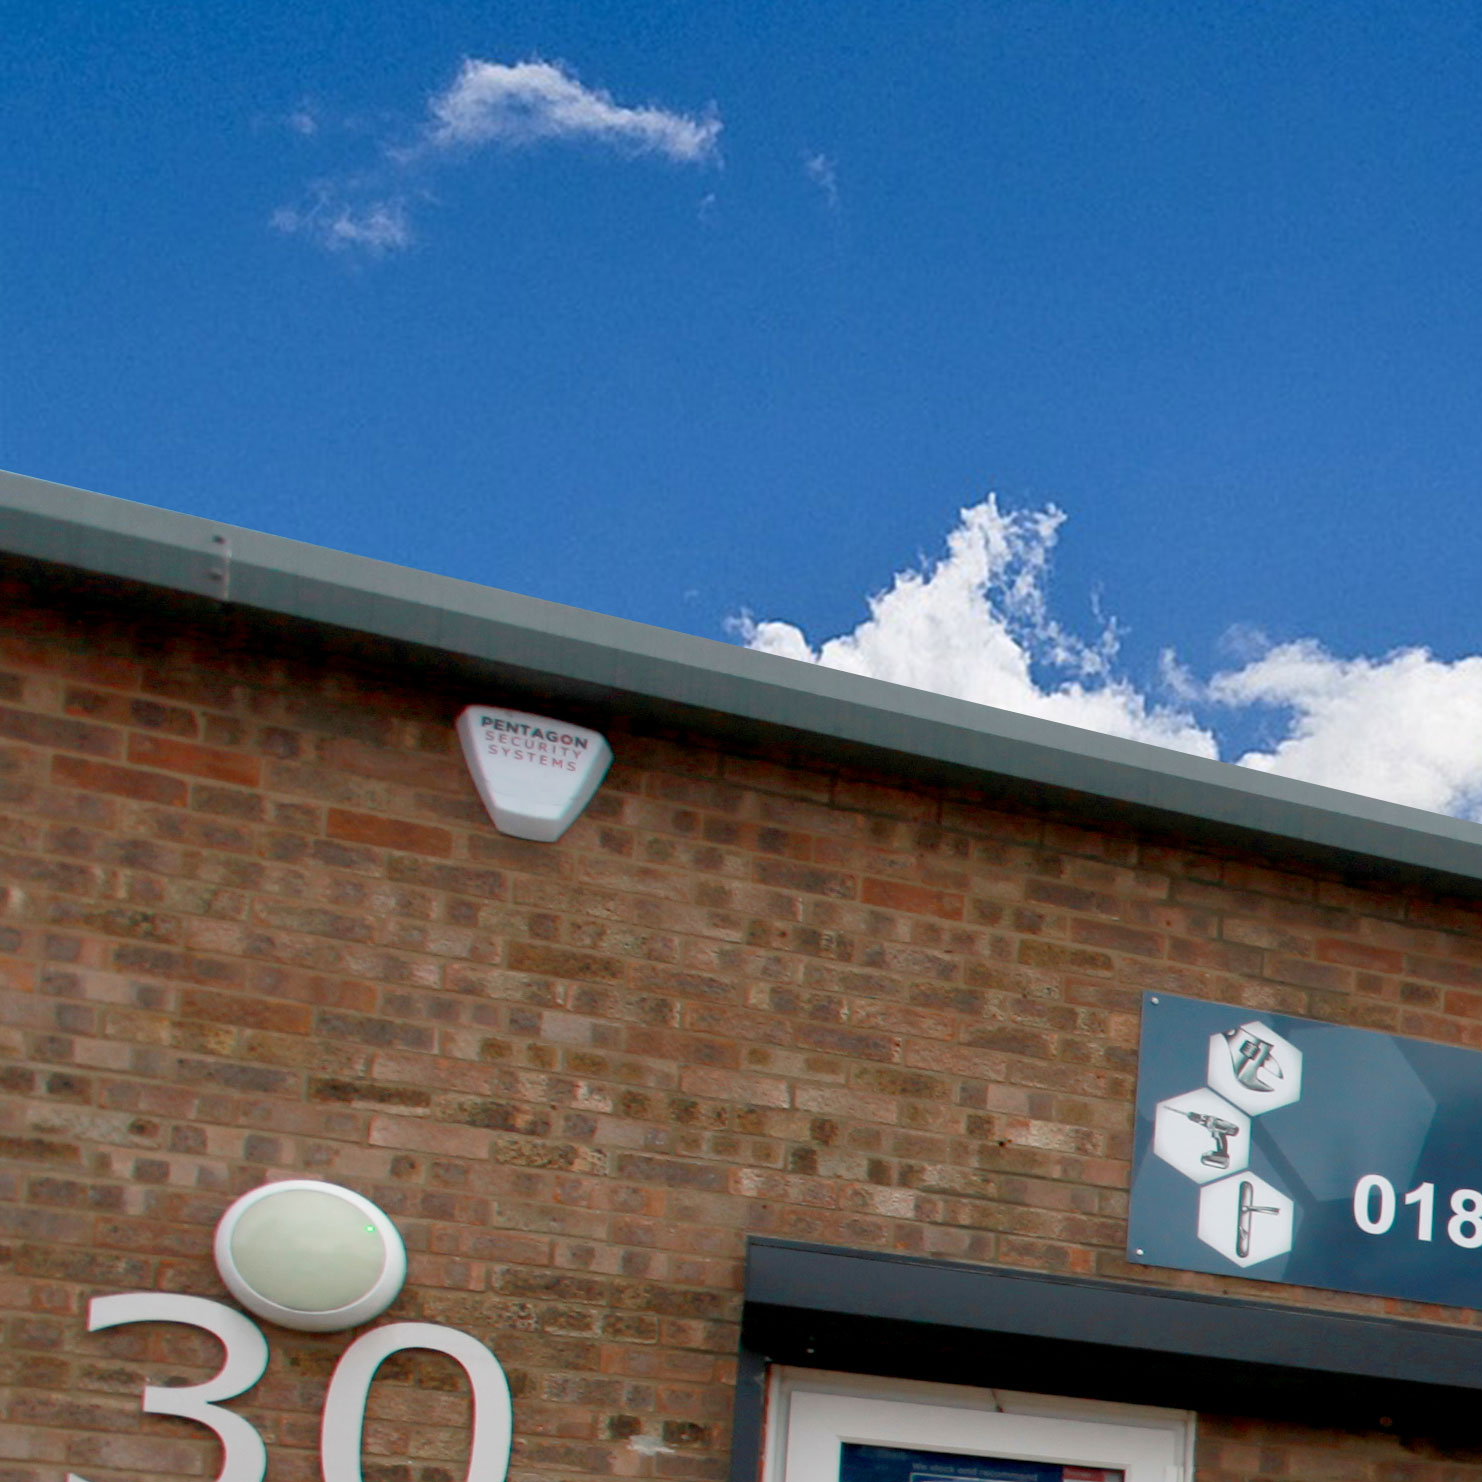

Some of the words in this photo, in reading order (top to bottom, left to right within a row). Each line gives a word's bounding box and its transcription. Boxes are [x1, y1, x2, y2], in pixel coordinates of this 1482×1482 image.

[480, 715, 588, 749] PENTAGON
[485, 730, 583, 759] SECURITY
[488, 744, 577, 772] SYSTEMS
